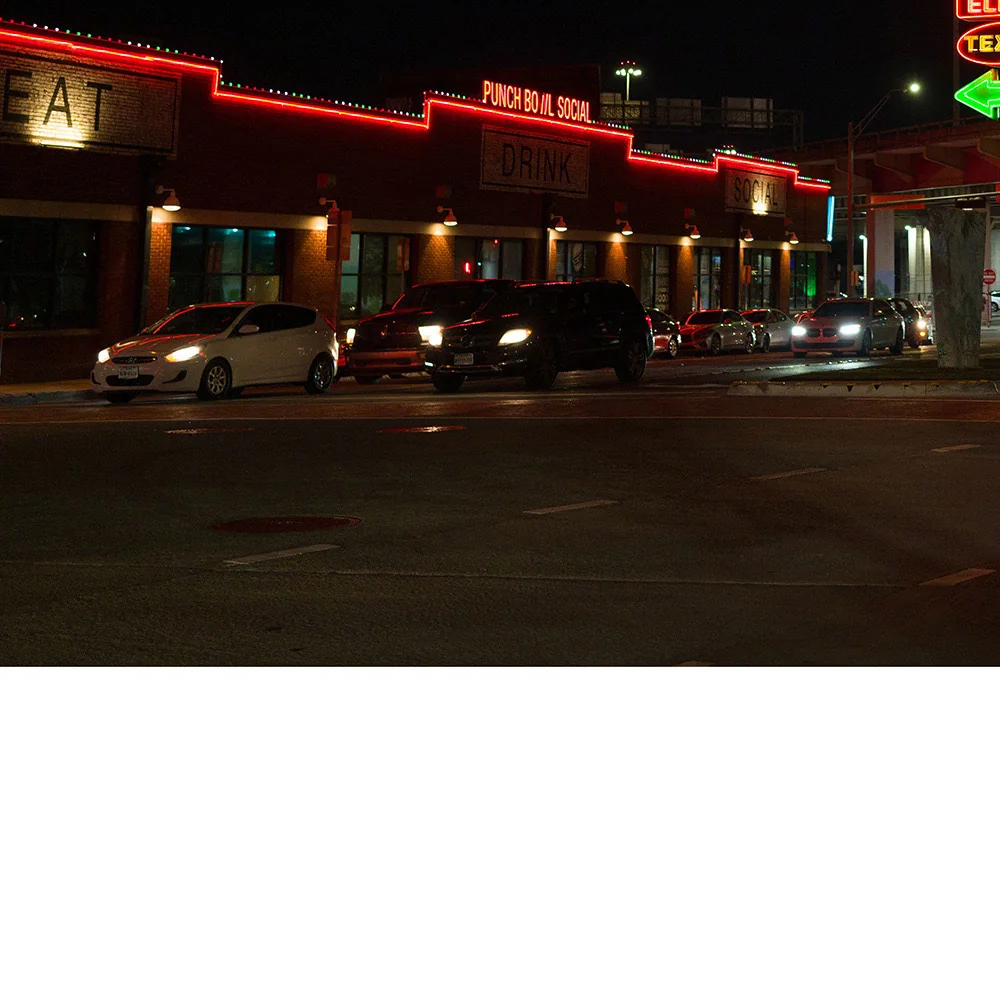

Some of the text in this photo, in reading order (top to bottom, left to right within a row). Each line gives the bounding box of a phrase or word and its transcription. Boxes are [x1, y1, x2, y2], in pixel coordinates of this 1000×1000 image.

[3, 69, 112, 131] EAT
[482, 79, 522, 110] PUNCH
[557, 95, 592, 123] SOCIAL
[502, 143, 572, 184] DRINK
[734, 177, 778, 206] SOCIAL
